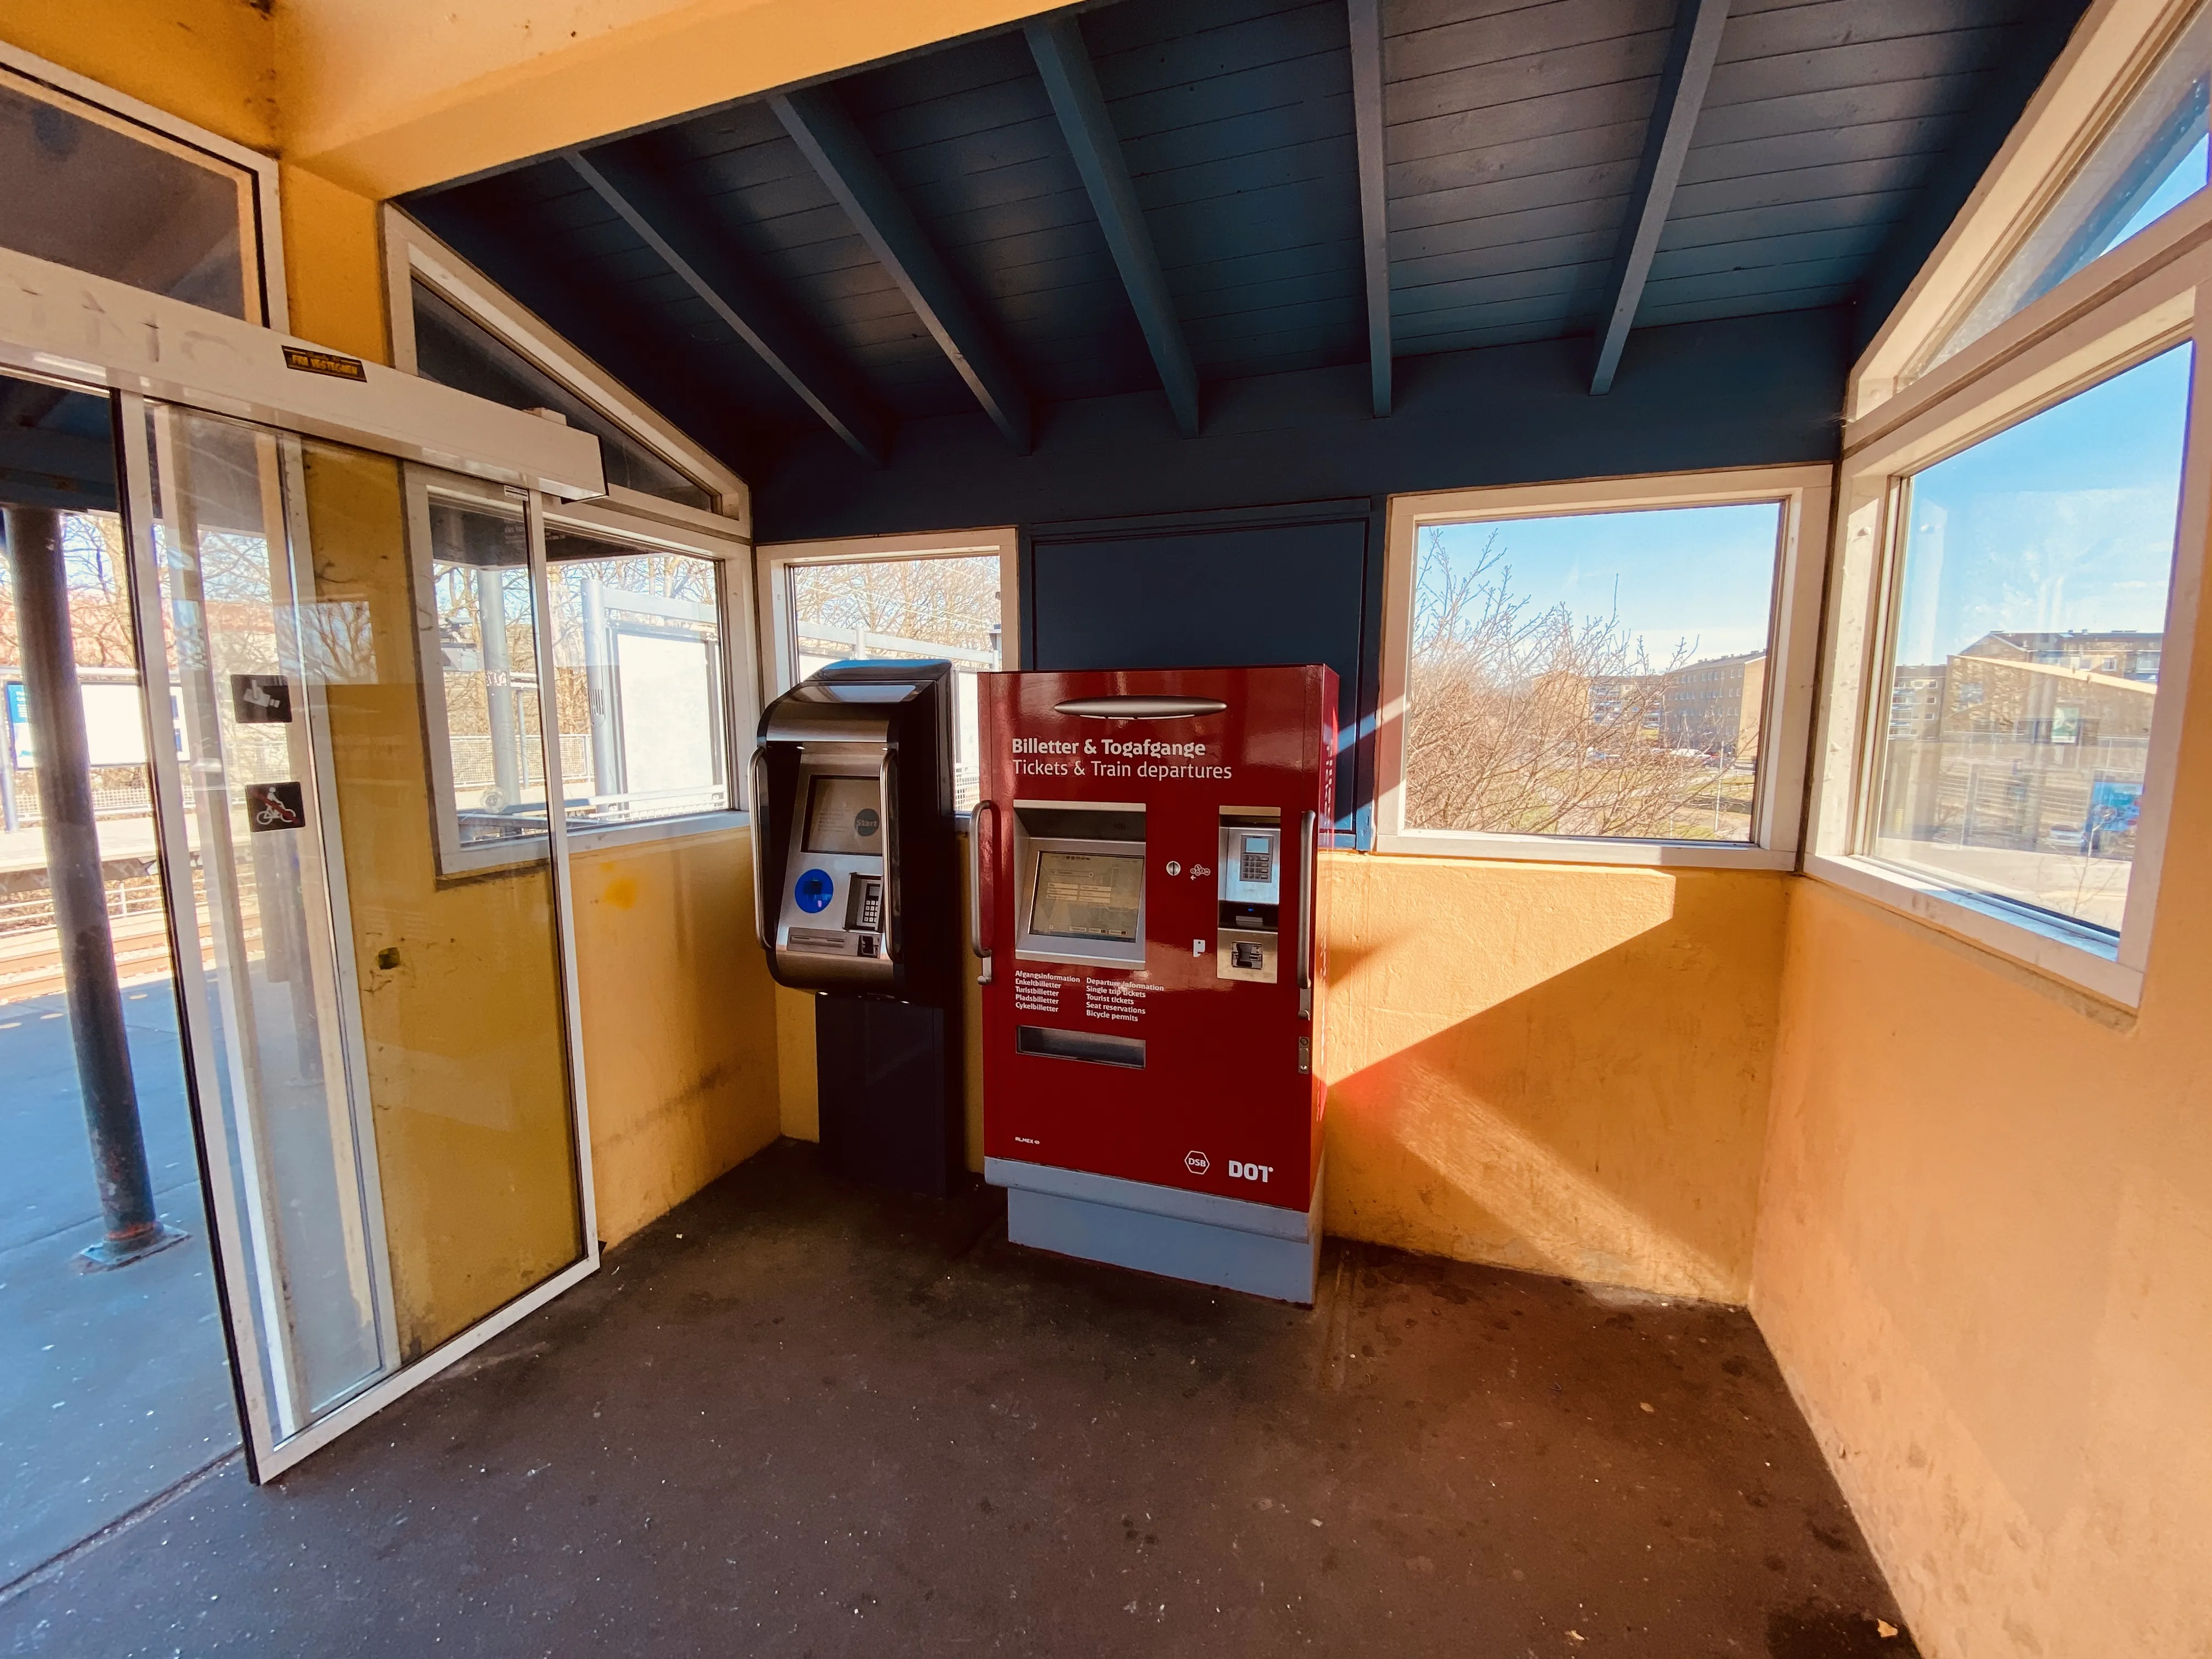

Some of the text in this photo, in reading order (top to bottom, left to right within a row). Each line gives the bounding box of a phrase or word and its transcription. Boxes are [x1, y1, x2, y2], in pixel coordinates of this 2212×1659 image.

[1012, 738, 1206, 758] Billetter & Togafgange
[1012, 759, 1232, 781] Tickets & Train departures
[856, 819, 878, 827] Start
[1015, 970, 1080, 983] Afgangsinformation
[1015, 978, 1062, 989] Enkeltbilletter
[1086, 977, 1164, 991] Departure information
[1015, 986, 1059, 997] Turistbilletter
[1086, 985, 1146, 998] Single trip tickets
[1015, 994, 1059, 1005] Pladsbilletter
[1086, 994, 1134, 1005] Tourist tickets
[1015, 1002, 1059, 1012] Cykelbilletter
[1086, 1001, 1146, 1014] Seat reservations
[1086, 1009, 1138, 1022] Bicycle permits
[1188, 1157, 1206, 1167] DSB
[1228, 1159, 1273, 1183] DOT
